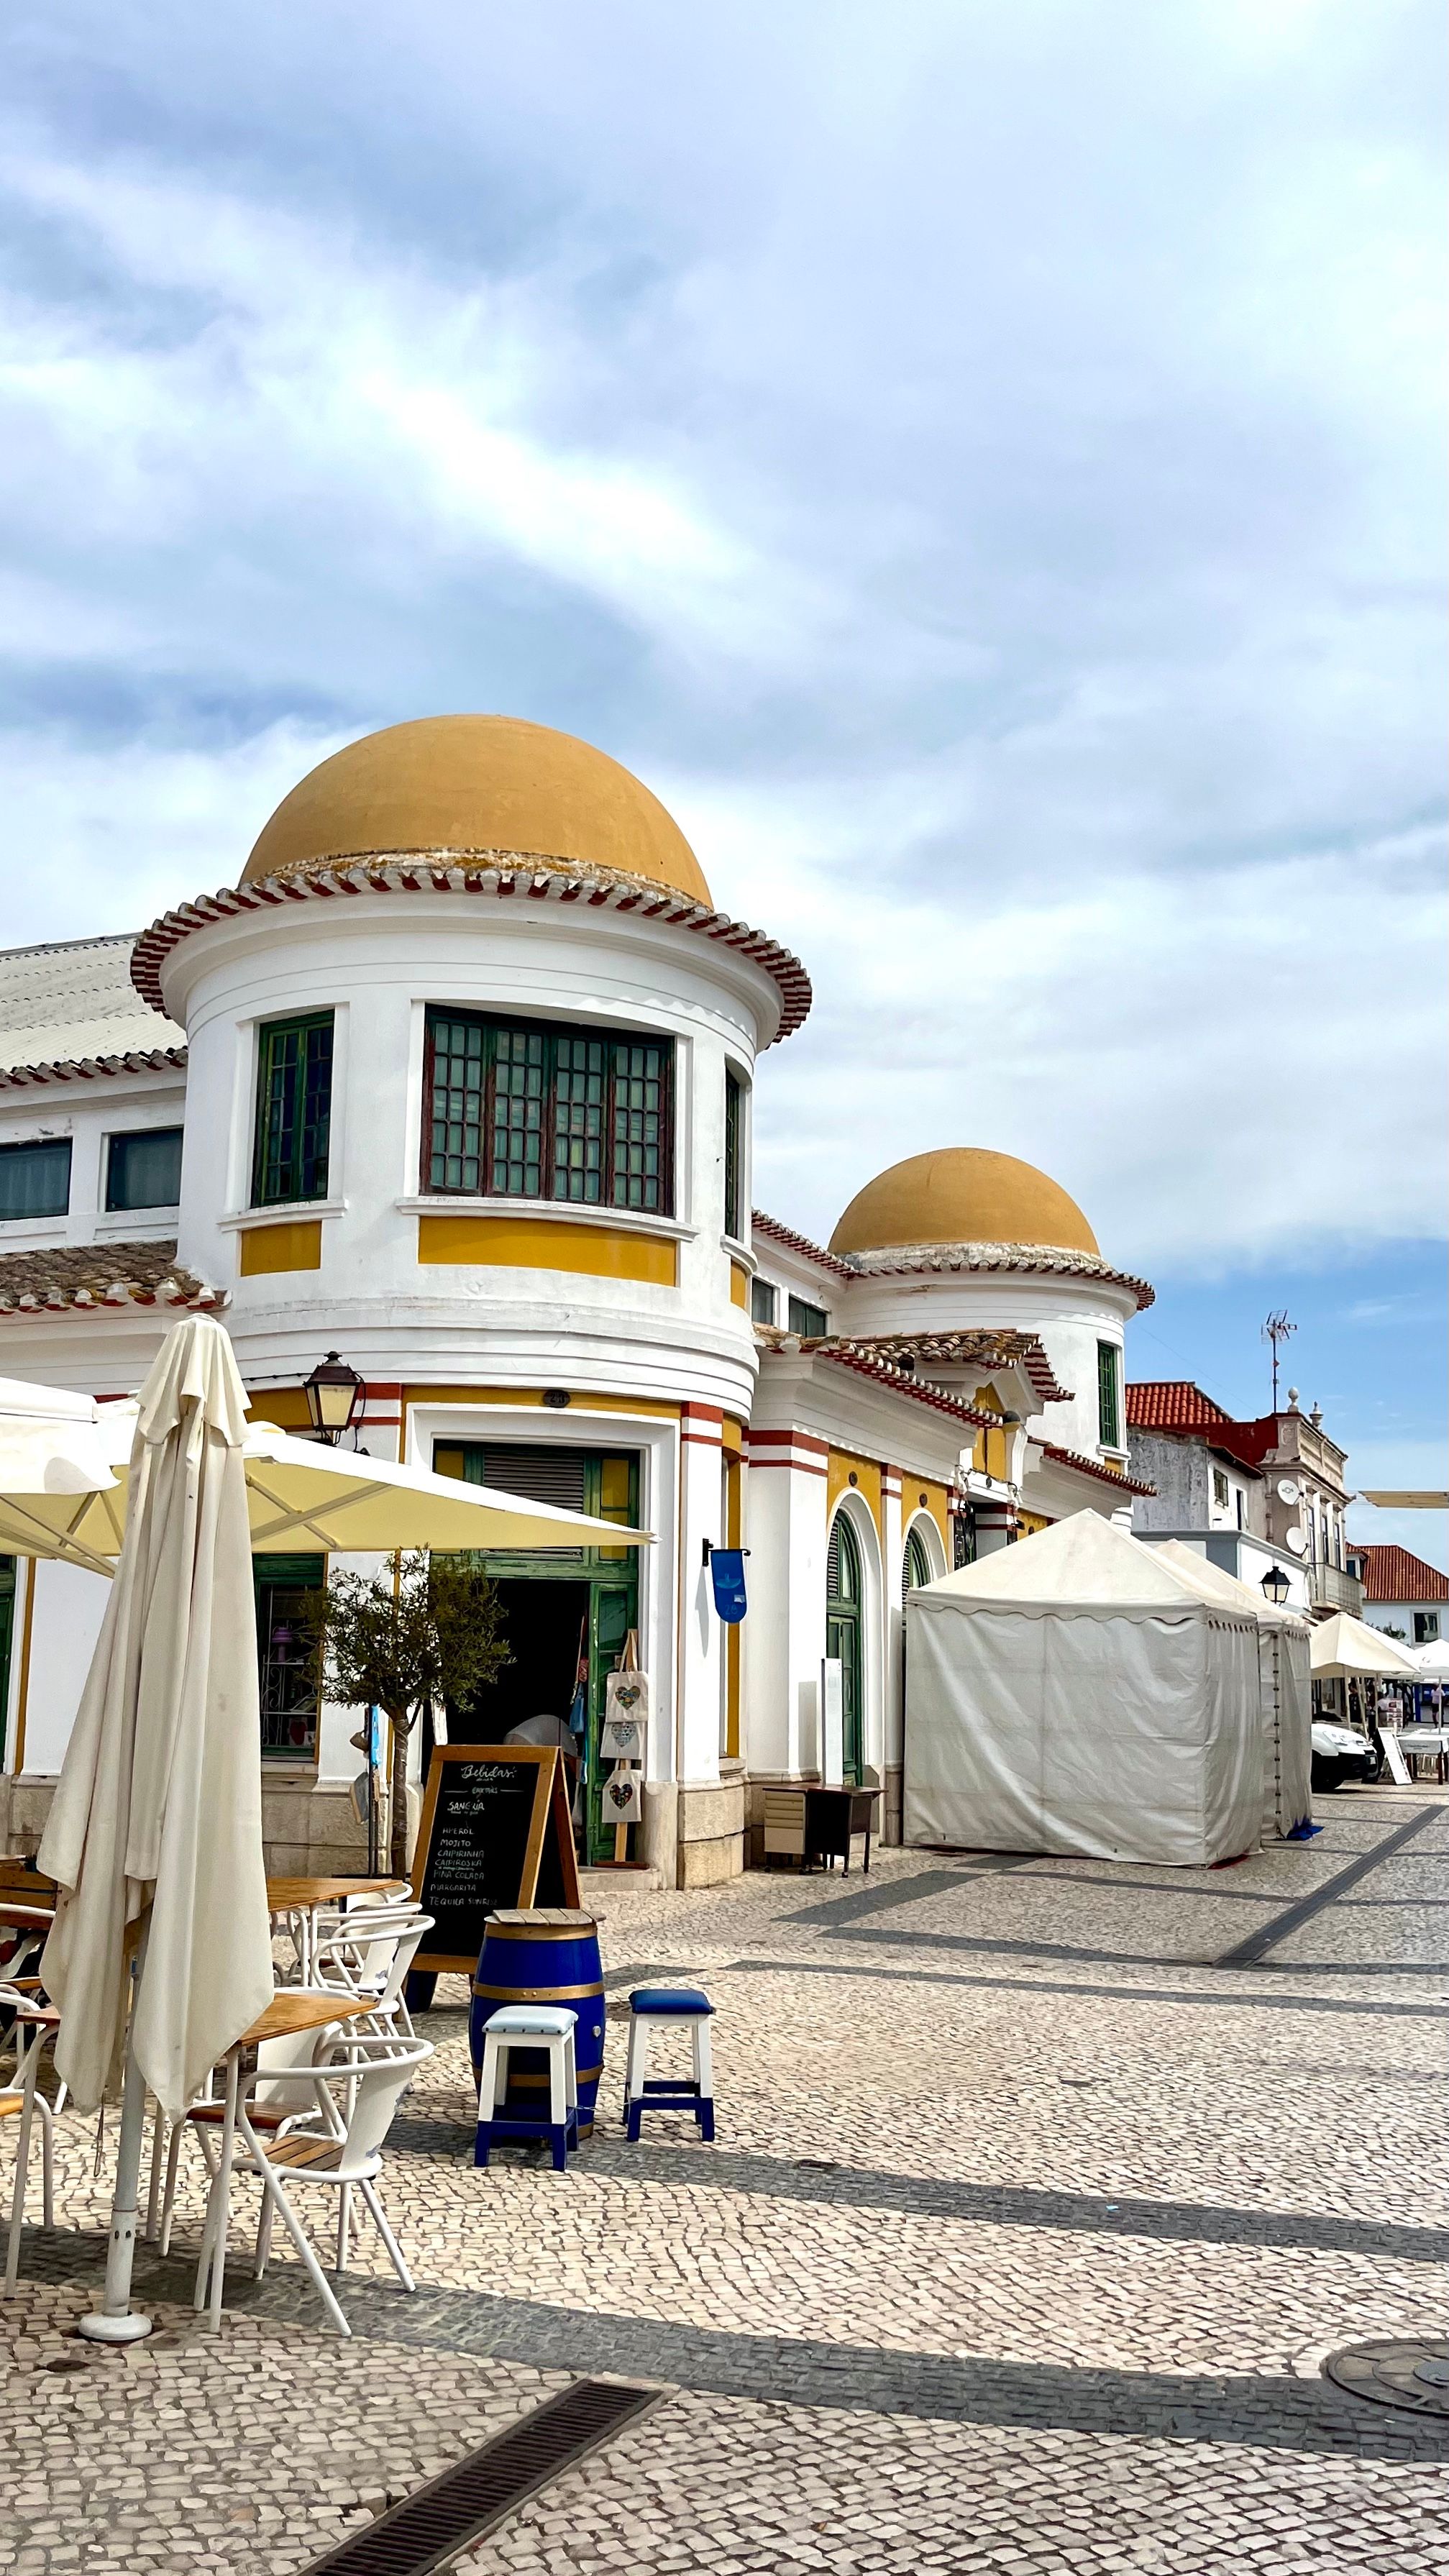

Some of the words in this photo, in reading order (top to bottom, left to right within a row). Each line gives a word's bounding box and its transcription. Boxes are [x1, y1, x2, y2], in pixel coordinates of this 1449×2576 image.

[440, 1839, 471, 1847] MOJITO
[437, 1850, 484, 1858] CAIPIRINHA
[454, 1871, 485, 1880] COLADA
[429, 1896, 465, 1906] TEQUILA
